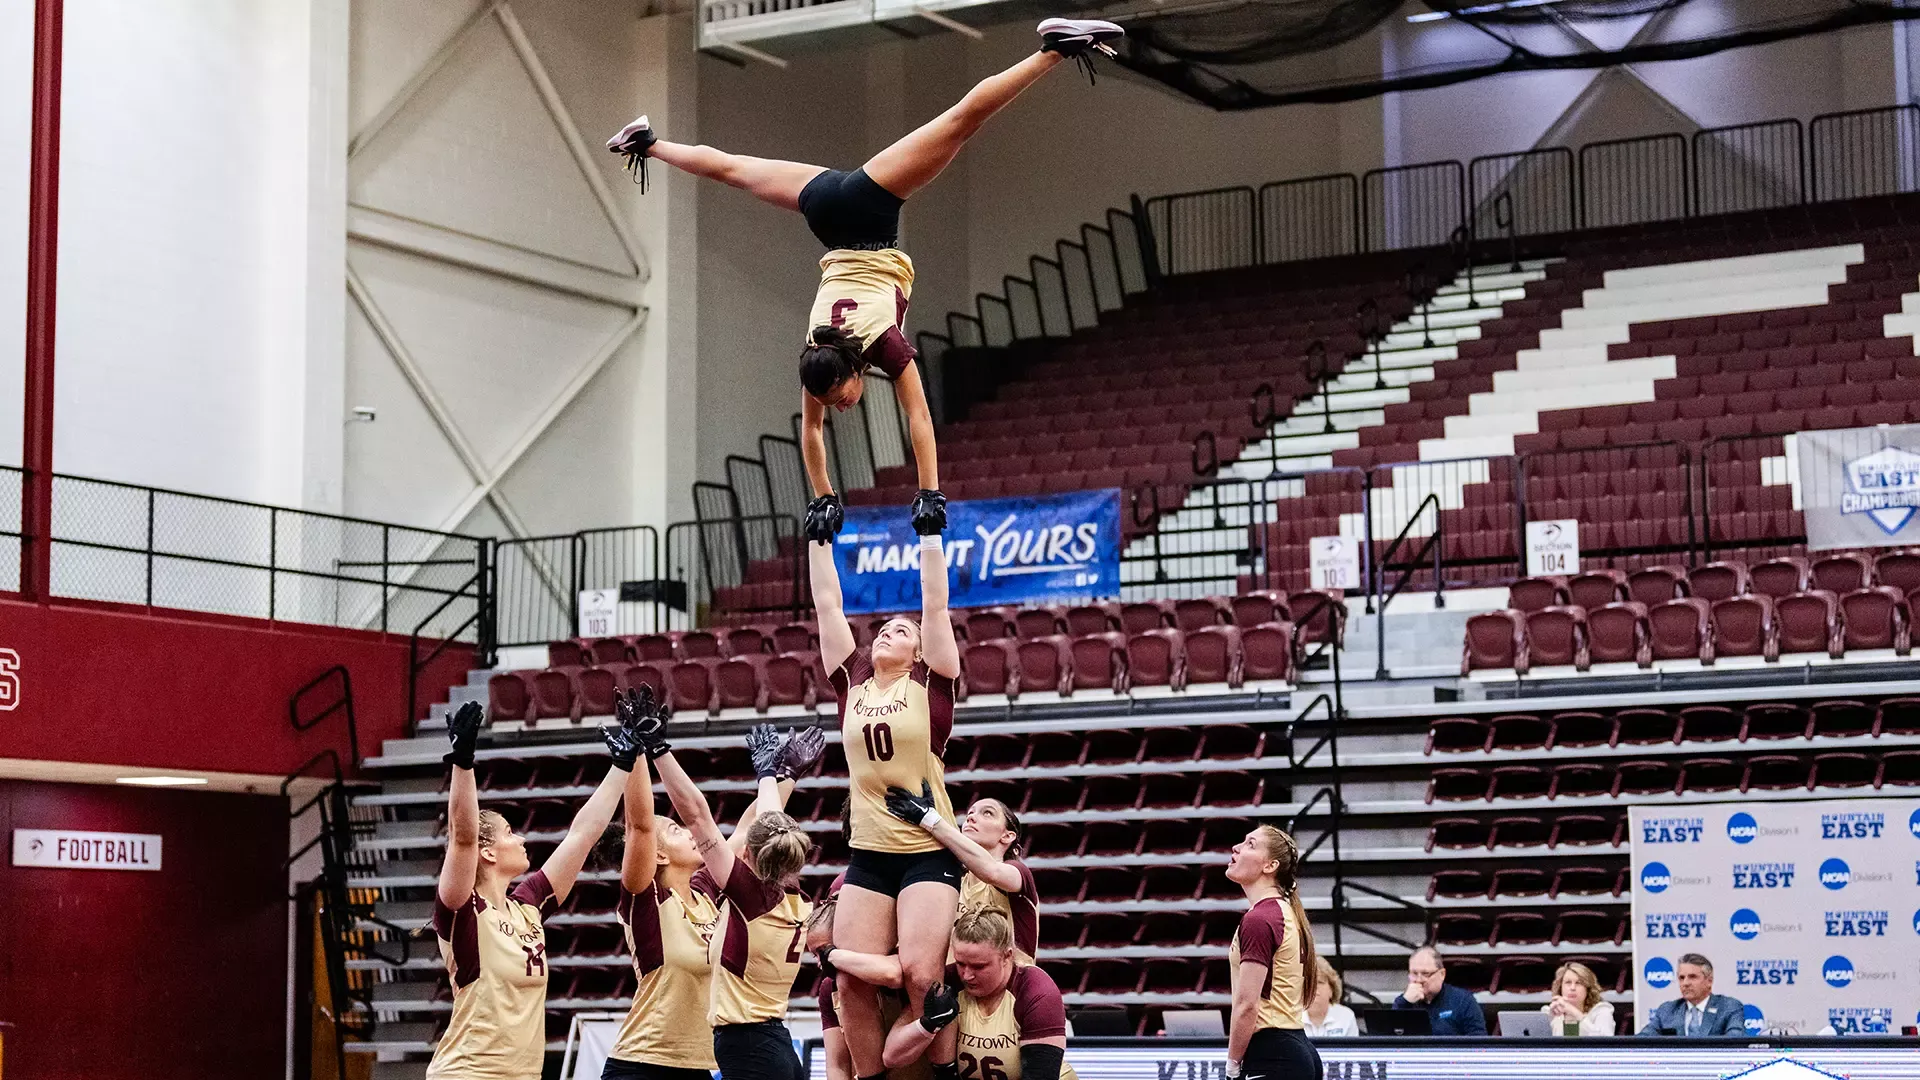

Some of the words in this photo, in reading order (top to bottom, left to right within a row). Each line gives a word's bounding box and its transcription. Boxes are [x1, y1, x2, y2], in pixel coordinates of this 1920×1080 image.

[856, 544, 921, 574] MAK
[976, 514, 1098, 580] YOURS
[1541, 553, 1565, 572] 104
[588, 619, 608, 634] 103
[862, 722, 894, 762] 10
[1643, 818, 1704, 829] MOUNTAIN
[1821, 813, 1885, 824] MOUNTAIN
[1643, 827, 1703, 843] EAST
[1822, 822, 1884, 839] EAST
[57, 838, 149, 864] FOOTBALL
[1733, 863, 1795, 873] MOUNTAIN
[1733, 872, 1794, 888] EAST
[1645, 913, 1706, 923] MOUNTAIN
[1825, 911, 1888, 921] MOUNTAIN
[1646, 922, 1706, 938] EAST
[1825, 920, 1888, 936] EAST
[1736, 960, 1799, 970] MOUNTAIN
[1737, 969, 1798, 985] EAST
[1744, 1018, 1764, 1029] CAA
[960, 1031, 1017, 1050] TZTOWN
[958, 1052, 1009, 1080] 26
